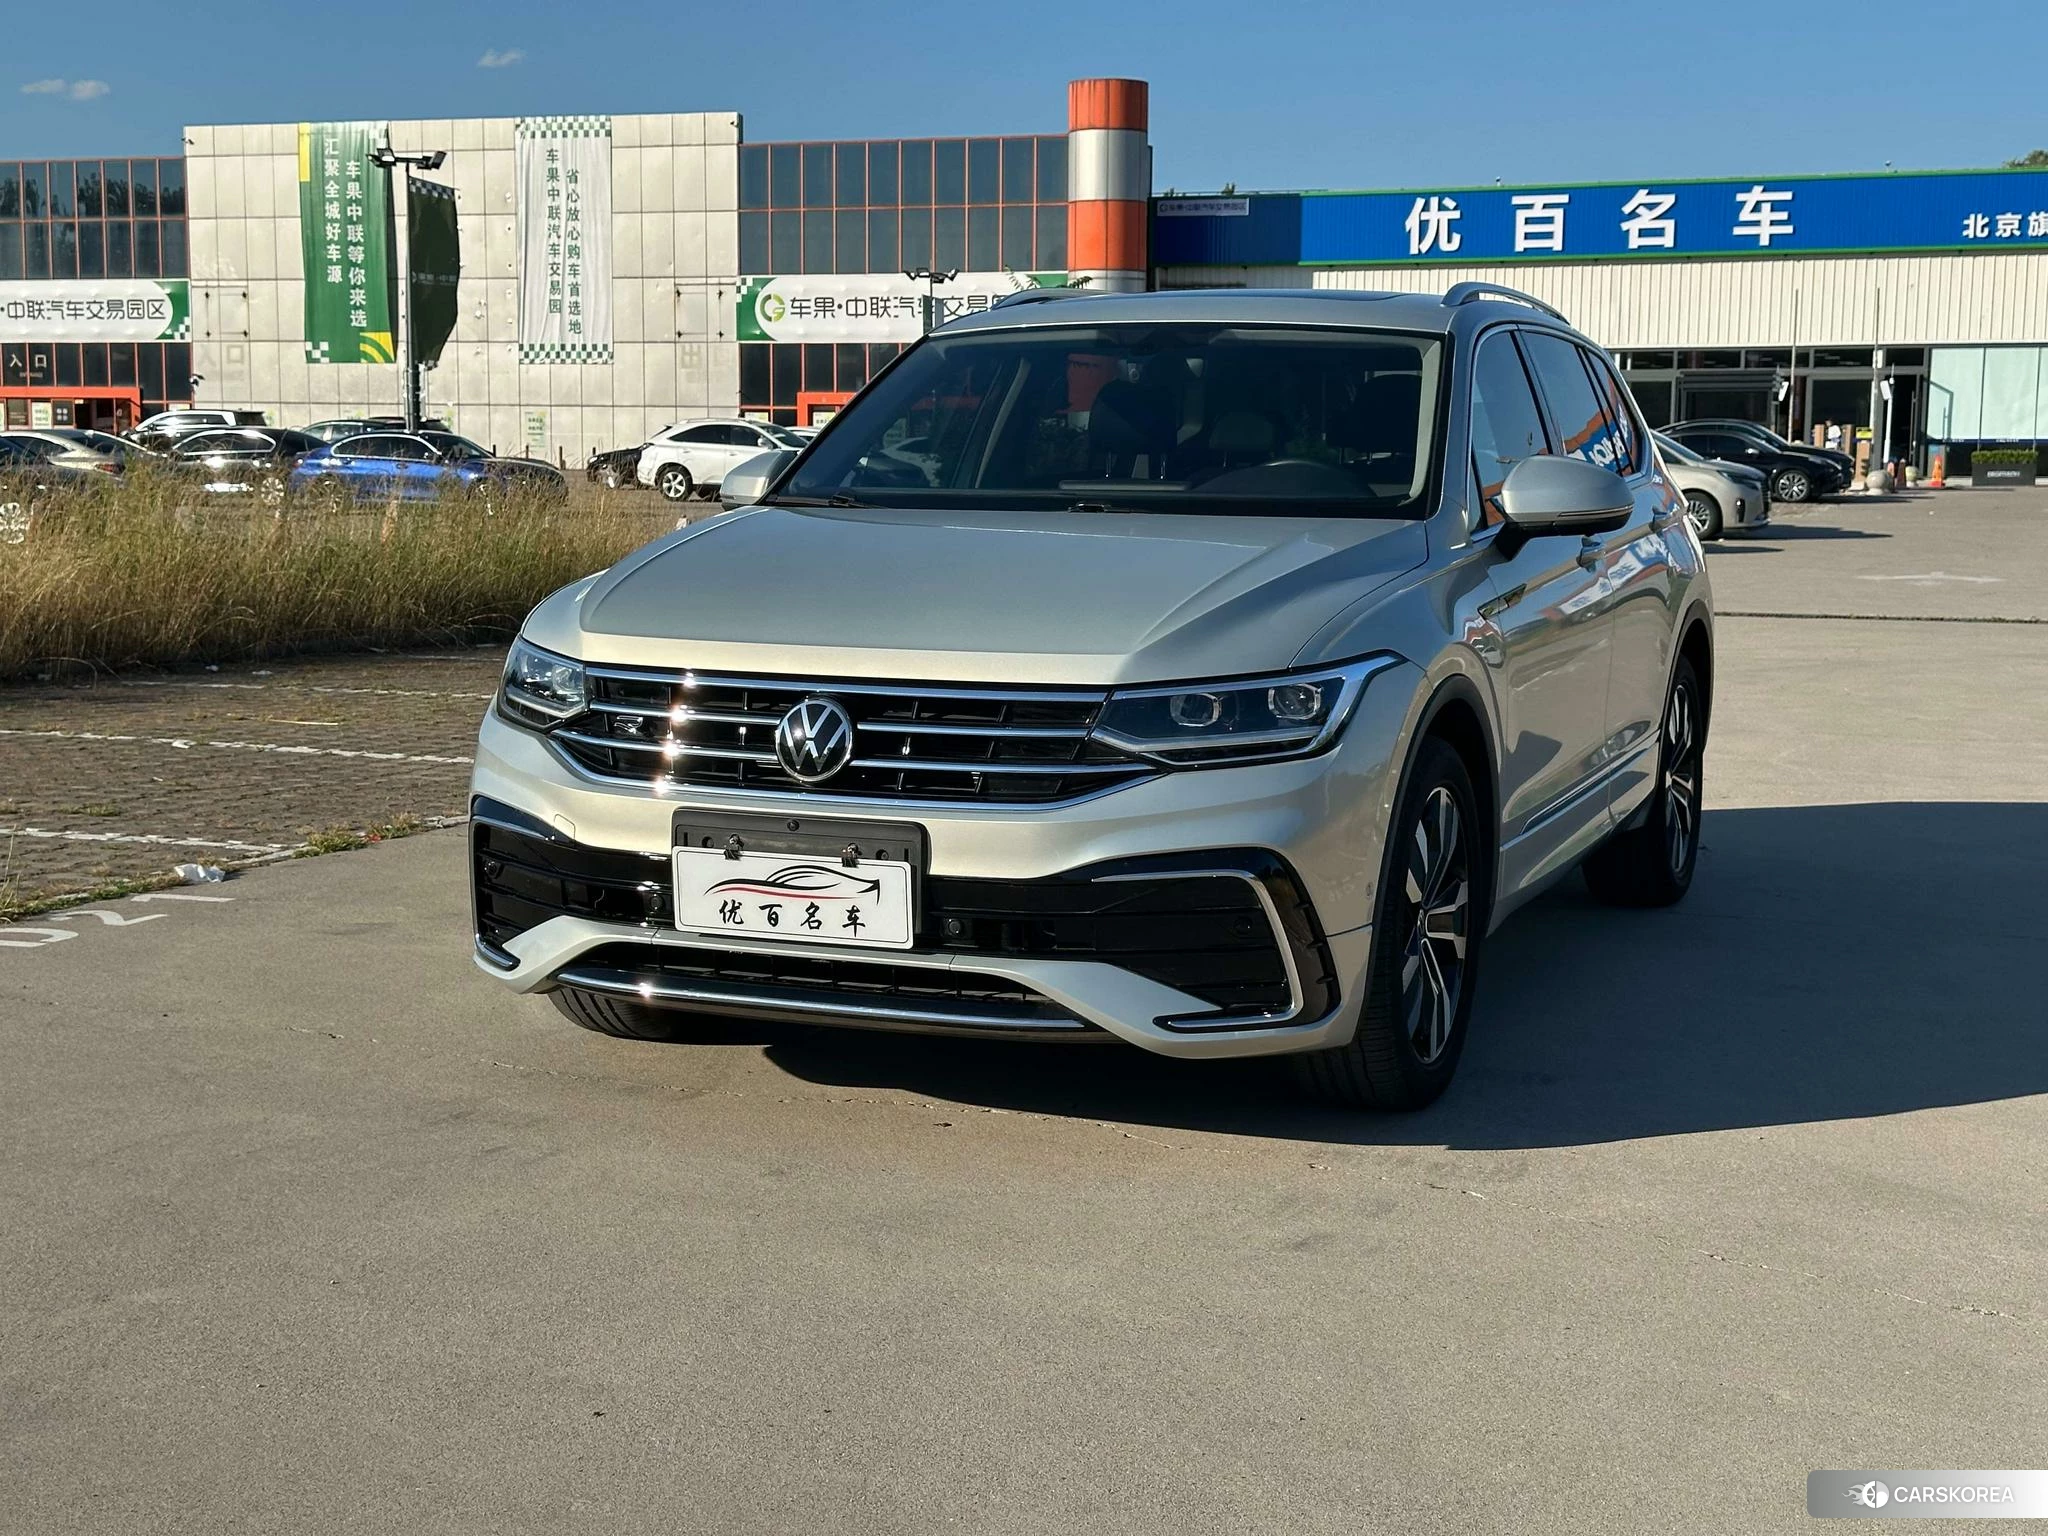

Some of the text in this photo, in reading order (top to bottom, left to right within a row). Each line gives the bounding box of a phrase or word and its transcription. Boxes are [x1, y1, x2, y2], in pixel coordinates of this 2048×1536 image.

[324, 137, 343, 284] 汇聚全城好车源
[346, 160, 368, 328] 车果中联等你来选
[546, 148, 562, 314] 车果中联汽车交易园
[566, 168, 582, 335] 省心放心购车首选地
[1405, 185, 1794, 255] 优百名车
[9, 354, 47, 369] 入口
[719, 899, 866, 938] 优百名车
